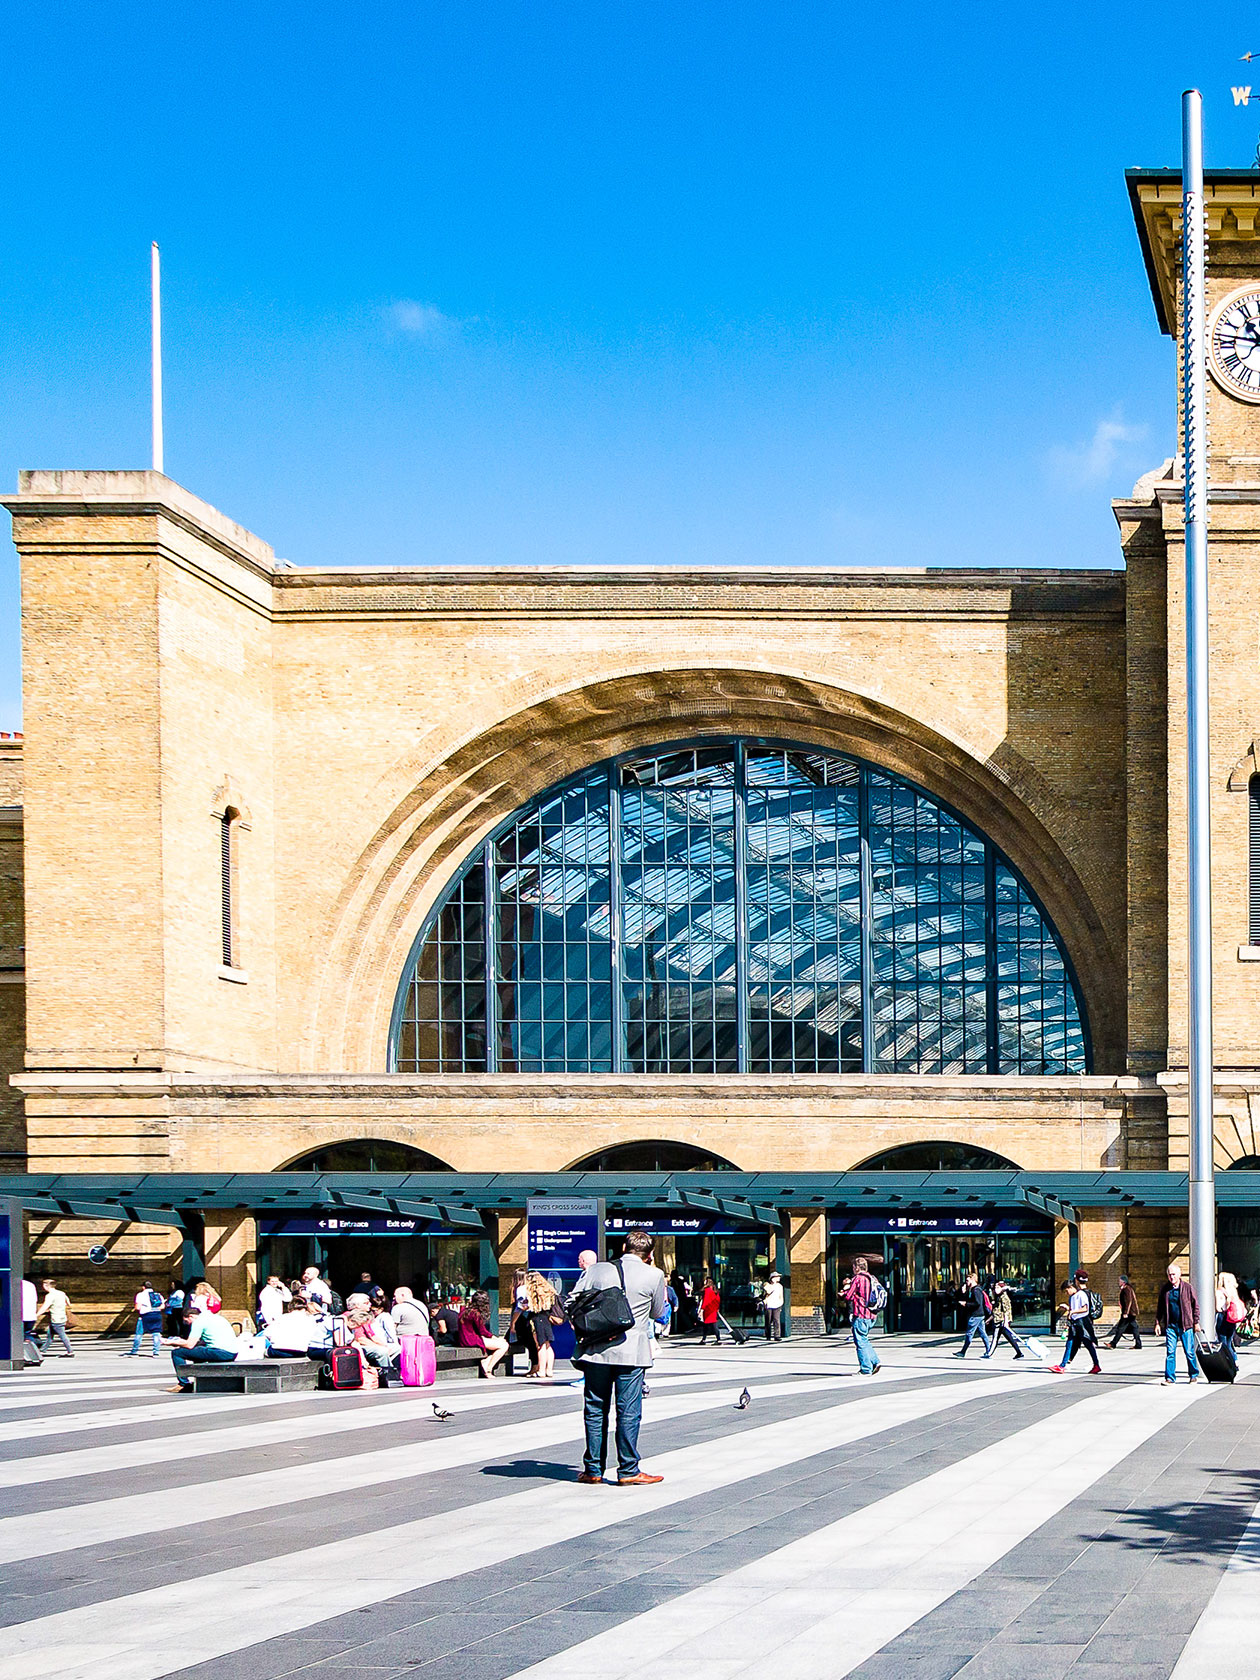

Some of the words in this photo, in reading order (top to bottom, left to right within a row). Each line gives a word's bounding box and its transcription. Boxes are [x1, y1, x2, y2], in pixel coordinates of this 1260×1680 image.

[1230, 86, 1252, 106] W
[340, 1220, 369, 1228] Entrance
[386, 1220, 400, 1228] Exit
[400, 1220, 415, 1229] only
[624, 1219, 653, 1227] Entrance
[671, 1219, 684, 1227] Exit
[685, 1219, 700, 1228] only
[908, 1218, 938, 1226] Entrance
[955, 1218, 968, 1226] Exit
[969, 1218, 984, 1227] only
